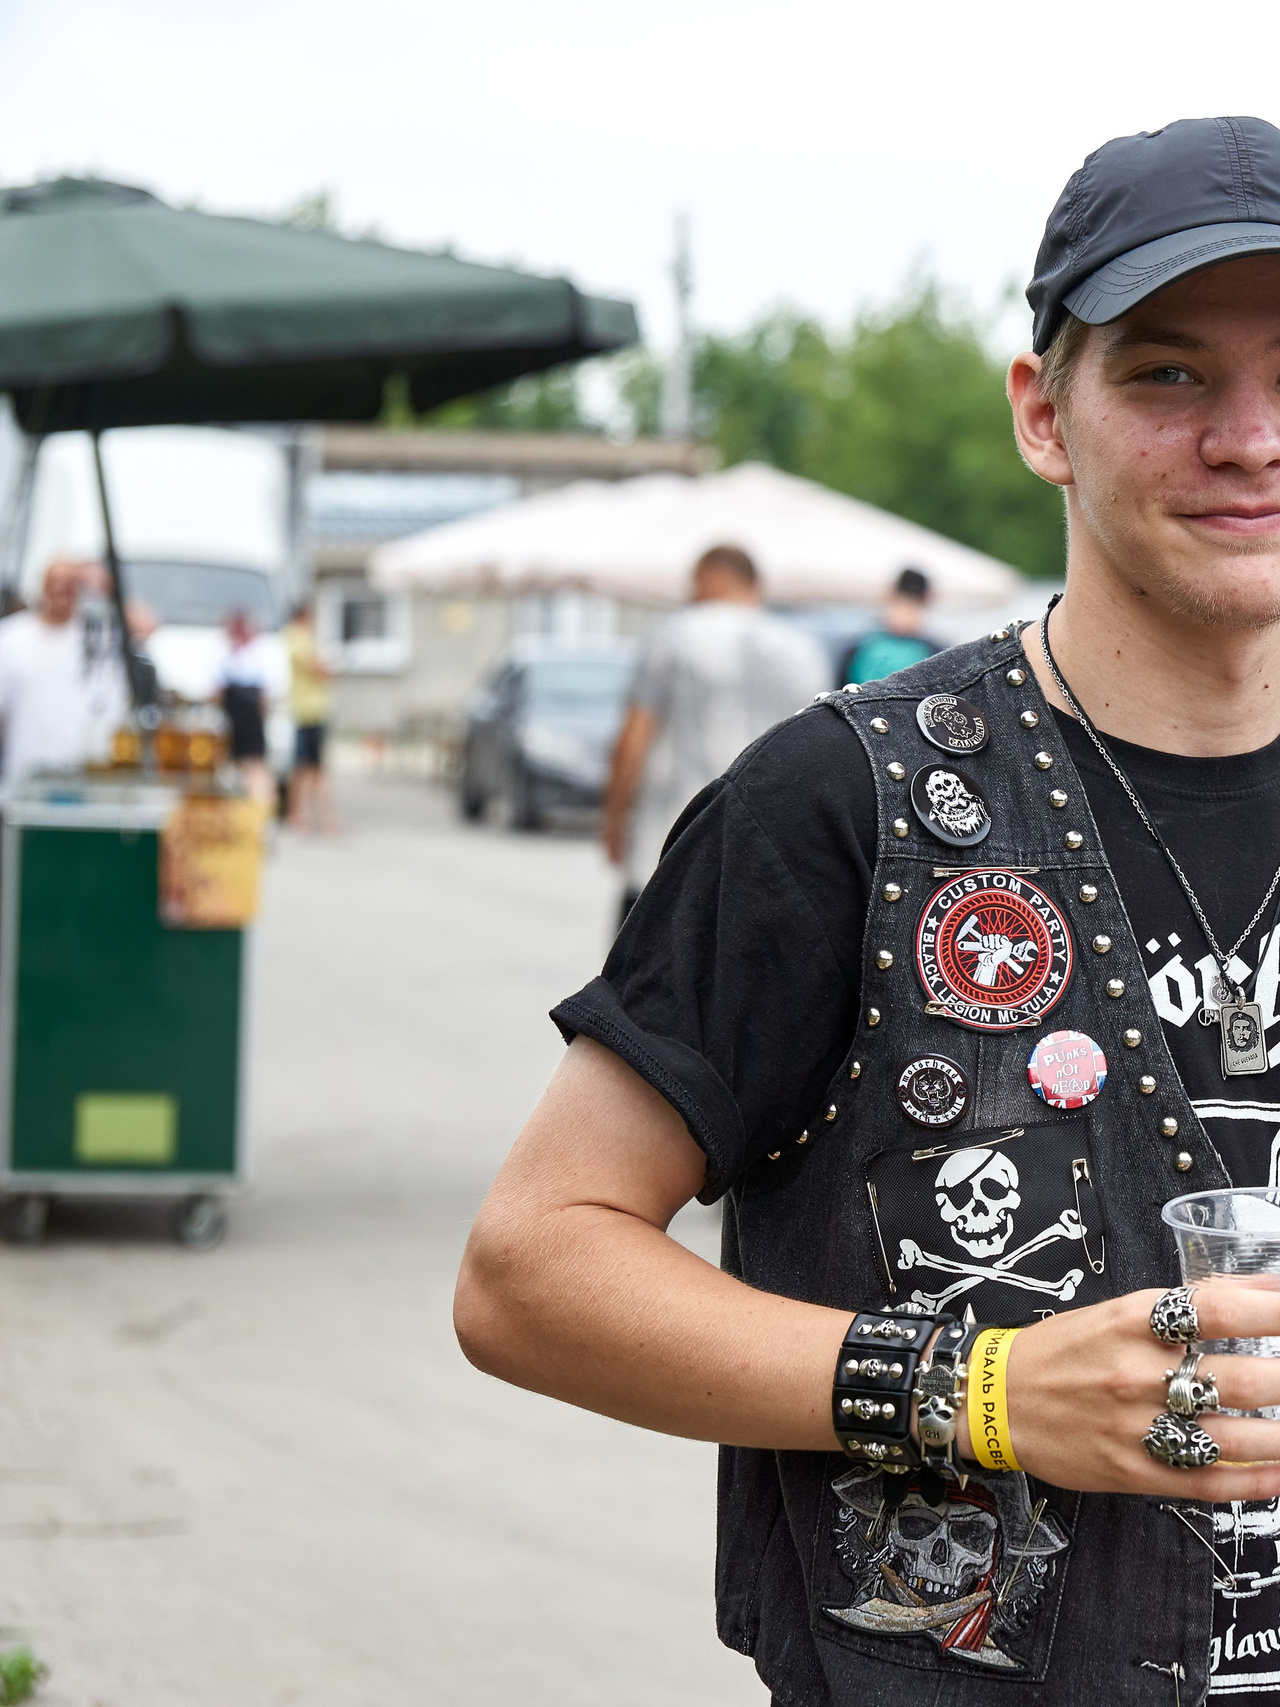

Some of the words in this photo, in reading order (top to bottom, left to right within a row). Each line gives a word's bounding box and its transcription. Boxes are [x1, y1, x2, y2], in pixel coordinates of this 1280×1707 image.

[938, 874, 1022, 910] CUSTOM
[1029, 894, 1066, 962] PARTY
[921, 932, 943, 988] BLACK
[938, 986, 991, 1023] LEGION
[997, 1010, 1019, 1024] MC
[1021, 986, 1056, 1016] TULA
[982, 1329, 1010, 1395] ТИВАЛЬ
